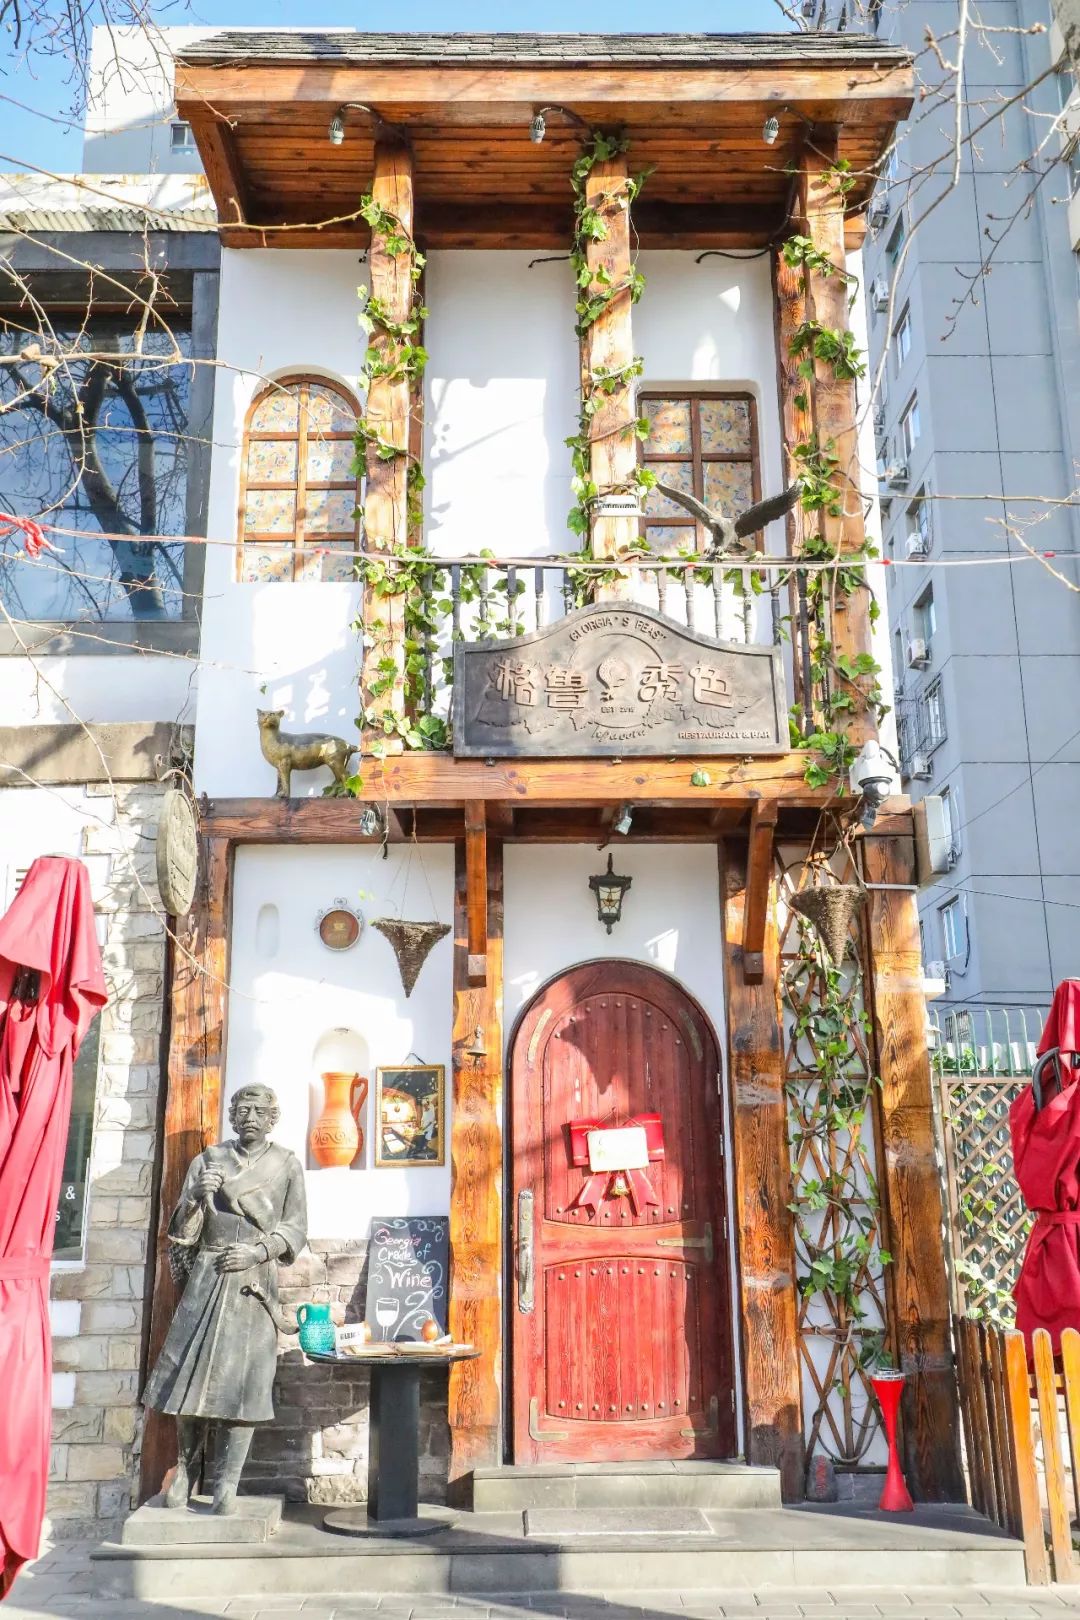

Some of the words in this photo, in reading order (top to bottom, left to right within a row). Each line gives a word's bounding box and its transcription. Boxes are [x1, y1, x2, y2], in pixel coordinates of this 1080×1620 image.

[678, 730, 740, 740] RESTAURANT
[65, 1185, 76, 1200] &
[378, 1246, 412, 1262] Cradle
[416, 1242, 432, 1261] of
[383, 1264, 433, 1289] Wine
